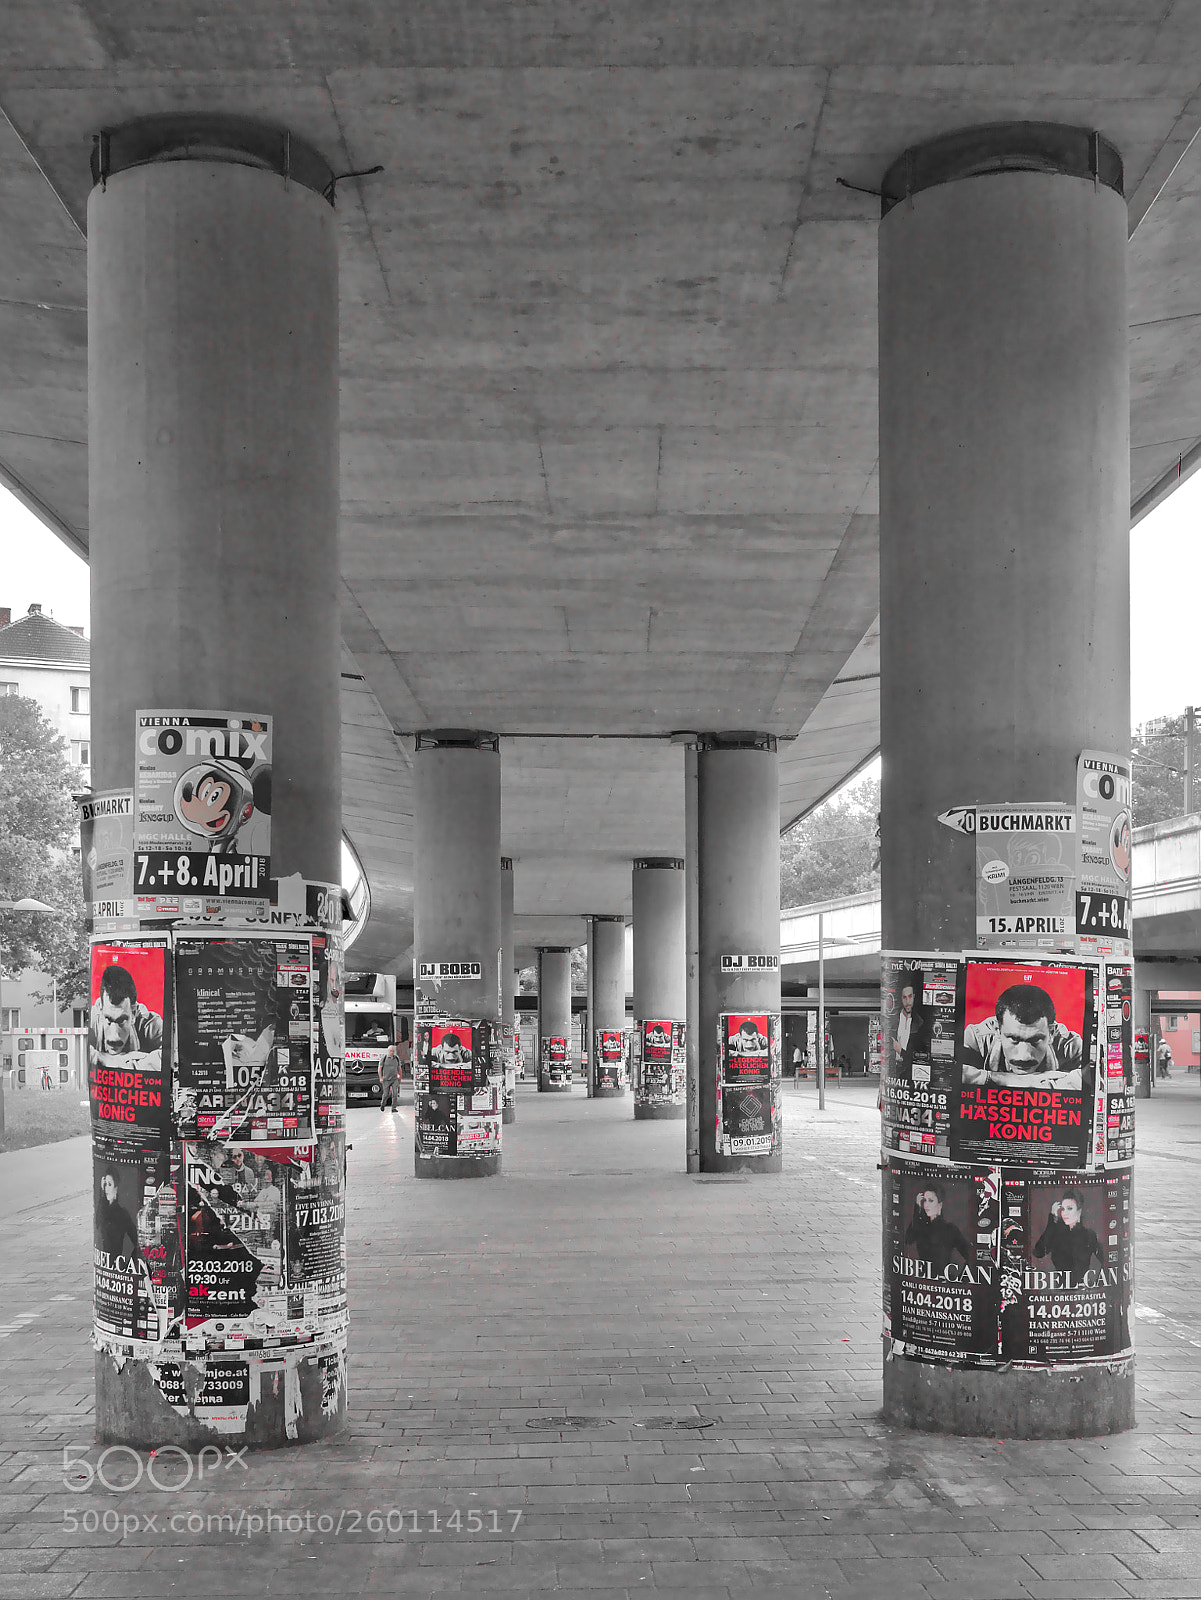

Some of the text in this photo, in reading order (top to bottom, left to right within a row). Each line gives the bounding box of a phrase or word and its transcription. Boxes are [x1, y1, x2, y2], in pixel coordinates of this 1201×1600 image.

[141, 717, 191, 726] VIENNA
[140, 720, 268, 760] comix
[1084, 760, 1119, 774] VIENNA
[979, 815, 1072, 831] BUCHMARKT
[138, 833, 159, 841] MGC
[138, 855, 259, 895] 7.+8. April
[258, 857, 267, 877] 2018
[986, 872, 1006, 881] KRIMI
[988, 917, 1059, 933] 15. APRIL
[420, 963, 481, 976] DJ BOBO
[721, 955, 778, 968] DJ BOBO
[93, 1069, 162, 1089] LEGENDE VOM
[279, 1075, 307, 1087] 018
[912, 1081, 931, 1090] YK
[886, 1089, 947, 1105] 16.06.2018
[961, 1087, 1082, 1108] DIE LEGENDE VOM
[960, 1102, 1082, 1126] HÄSSLICHEN
[733, 1135, 772, 1147] 09.01.2019
[295, 1202, 309, 1211] LIVE
[115, 1255, 147, 1278] CAN
[188, 1259, 254, 1273] 23.03.2018
[188, 1274, 230, 1285] 19:30 Uhr
[944, 1263, 994, 1286] CAN
[1082, 1266, 1119, 1290] CAN
[188, 1283, 246, 1301] akzent
[901, 1280, 973, 1297] CANLI ORKESTRASIYLA
[901, 1289, 973, 1313] 14.04.2018
[1028, 1292, 1107, 1302] CANLI ORKESTRASIYLA
[902, 1305, 973, 1324] HAN RENAISSANCE
[1027, 1301, 1107, 1320] 14.04.2018
[956, 1323, 972, 1331] Wien
[1028, 1317, 1107, 1330] HAN RENAISSANCE
